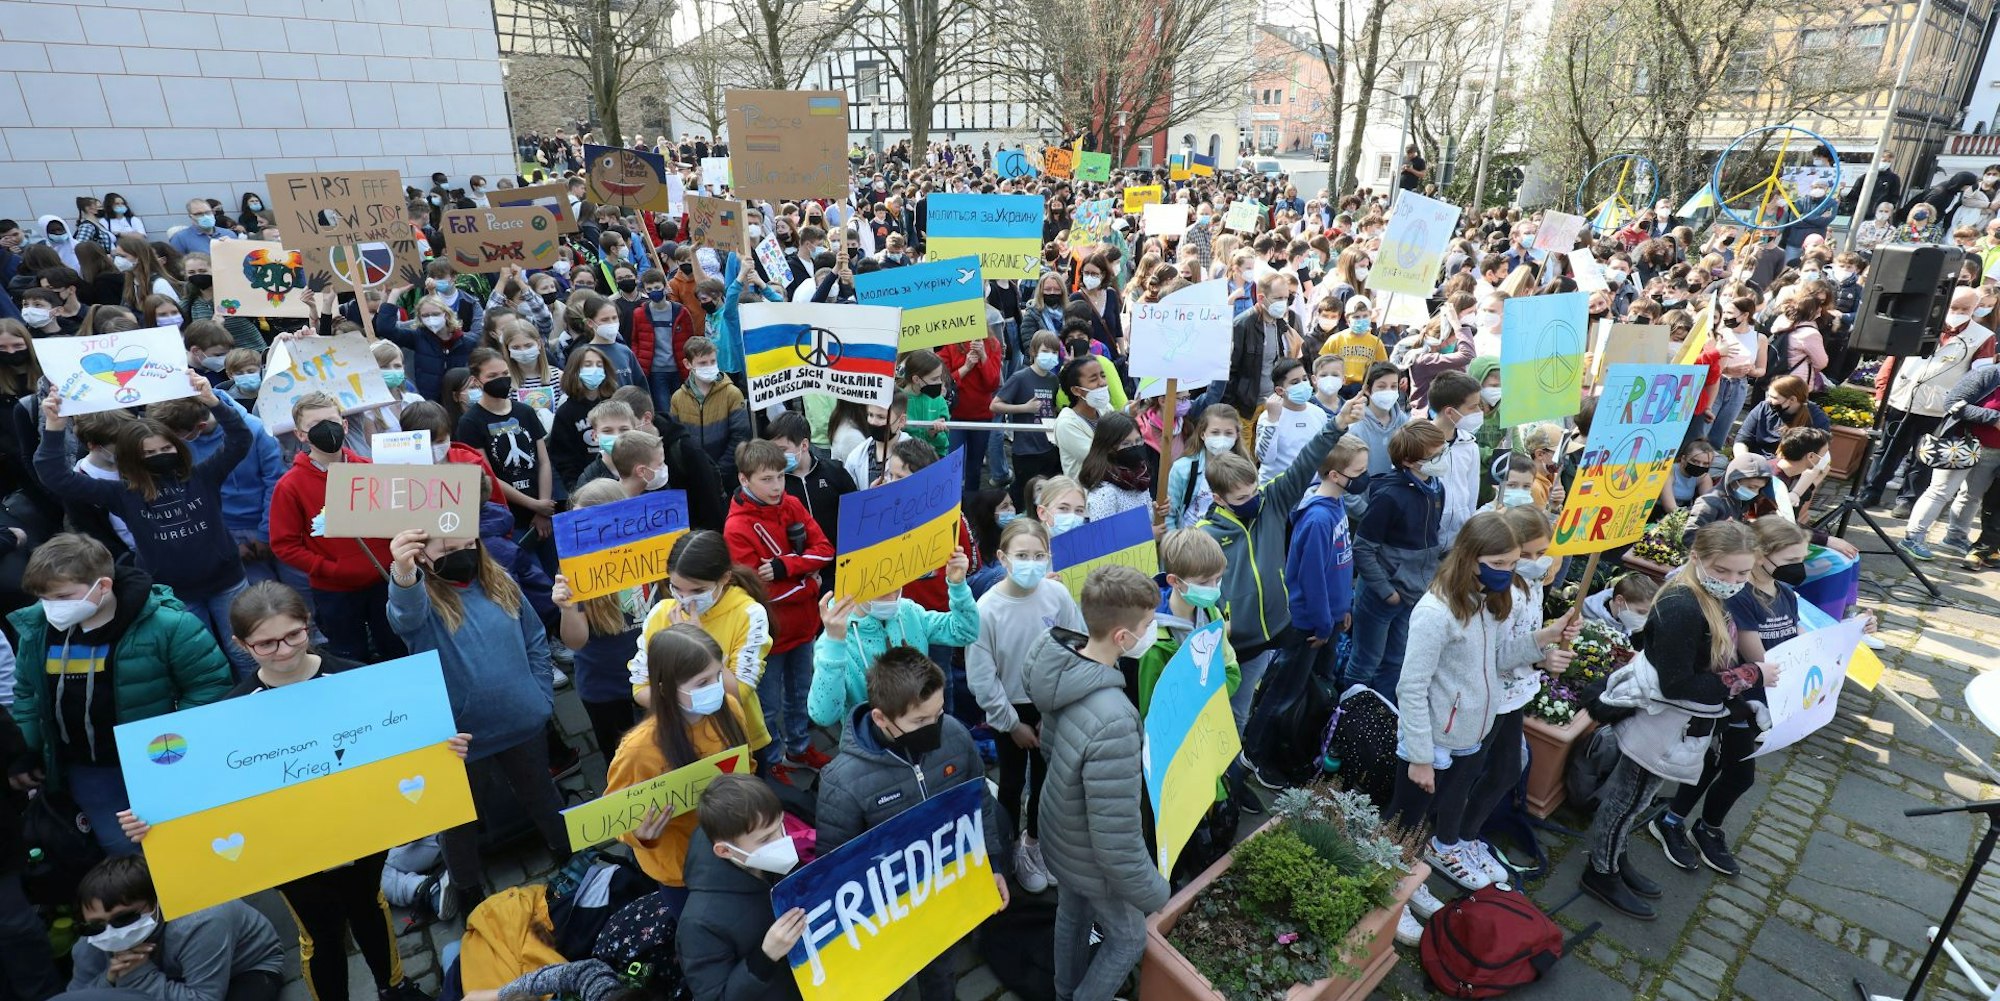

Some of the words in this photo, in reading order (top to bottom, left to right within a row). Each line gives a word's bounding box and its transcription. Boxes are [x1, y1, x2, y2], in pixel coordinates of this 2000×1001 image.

[288, 176, 350, 200] FIRST
[362, 178, 389, 199] FFF
[296, 205, 360, 234] NOW
[366, 204, 401, 227] STOP
[484, 212, 524, 231] Peace
[325, 232, 362, 245] THE
[364, 228, 390, 240] WAR
[901, 324, 920, 338] FOR
[925, 315, 976, 333] UKRAINE
[1138, 304, 1170, 324] Stop
[1174, 306, 1194, 320] the
[1199, 307, 1222, 320] War
[81, 335, 119, 353] STOP
[752, 368, 792, 391] MÖGEN
[754, 390, 774, 402] UND
[775, 380, 820, 396] RUSSLAND
[1606, 374, 1706, 426] FRIEDEN
[1581, 445, 1611, 478] FÜR
[1651, 449, 1676, 472] DIE
[140, 498, 203, 520] CHAUMNT
[350, 476, 461, 512] FRIEDEN
[858, 477, 953, 537] Frieden
[574, 504, 679, 550] Frieden
[1556, 499, 1657, 546] UKRAINE
[574, 548, 668, 595] UKRAINE
[842, 528, 947, 599] UKRAINE
[226, 739, 318, 770] Gemeinsam
[332, 723, 373, 748] gegen
[382, 710, 408, 728] den
[651, 780, 667, 790] die
[802, 808, 987, 986] FRIEDEN
